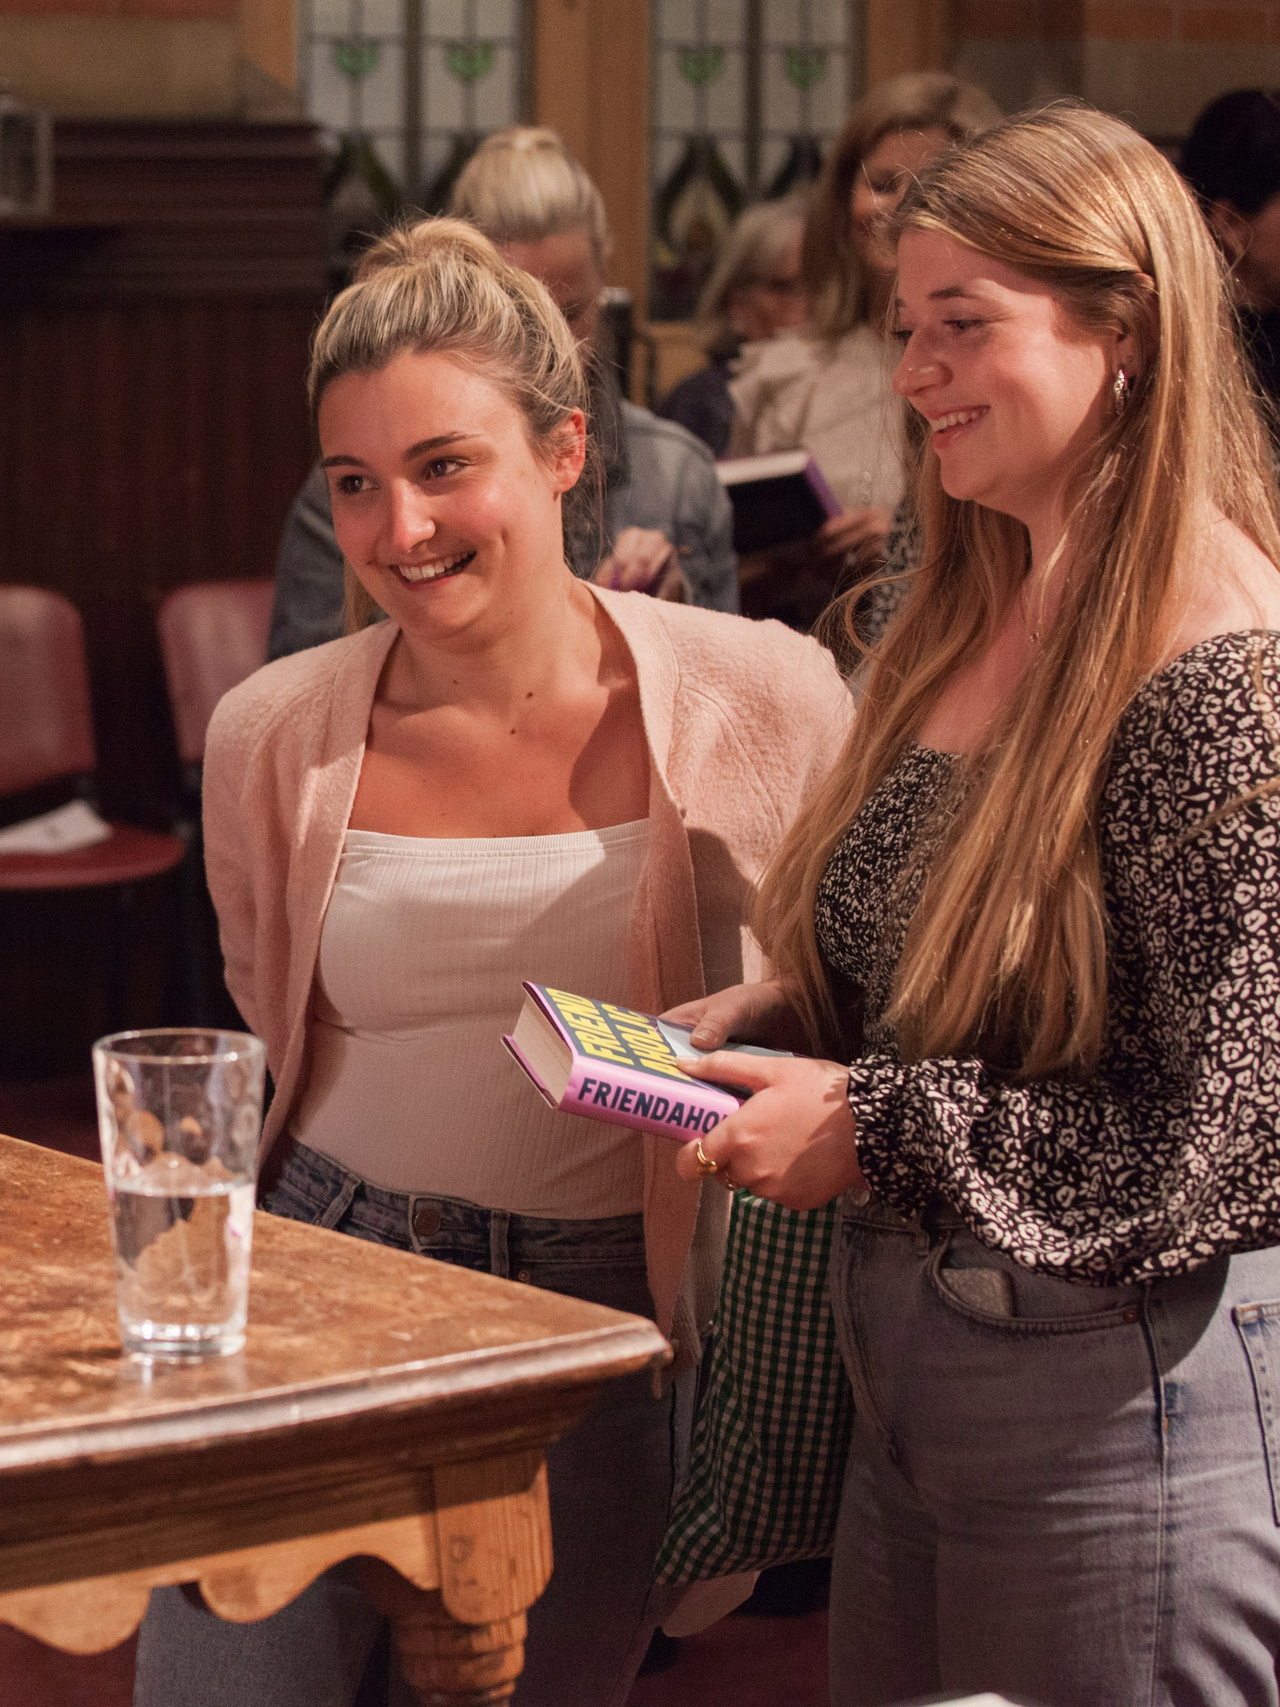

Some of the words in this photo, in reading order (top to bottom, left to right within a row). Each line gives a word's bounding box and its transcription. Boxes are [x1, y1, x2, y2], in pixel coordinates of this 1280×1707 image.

[545, 987, 635, 1066] FRIEND
[601, 1003, 693, 1081] AHOLIC
[577, 1077, 729, 1135] FRIENDAHO
